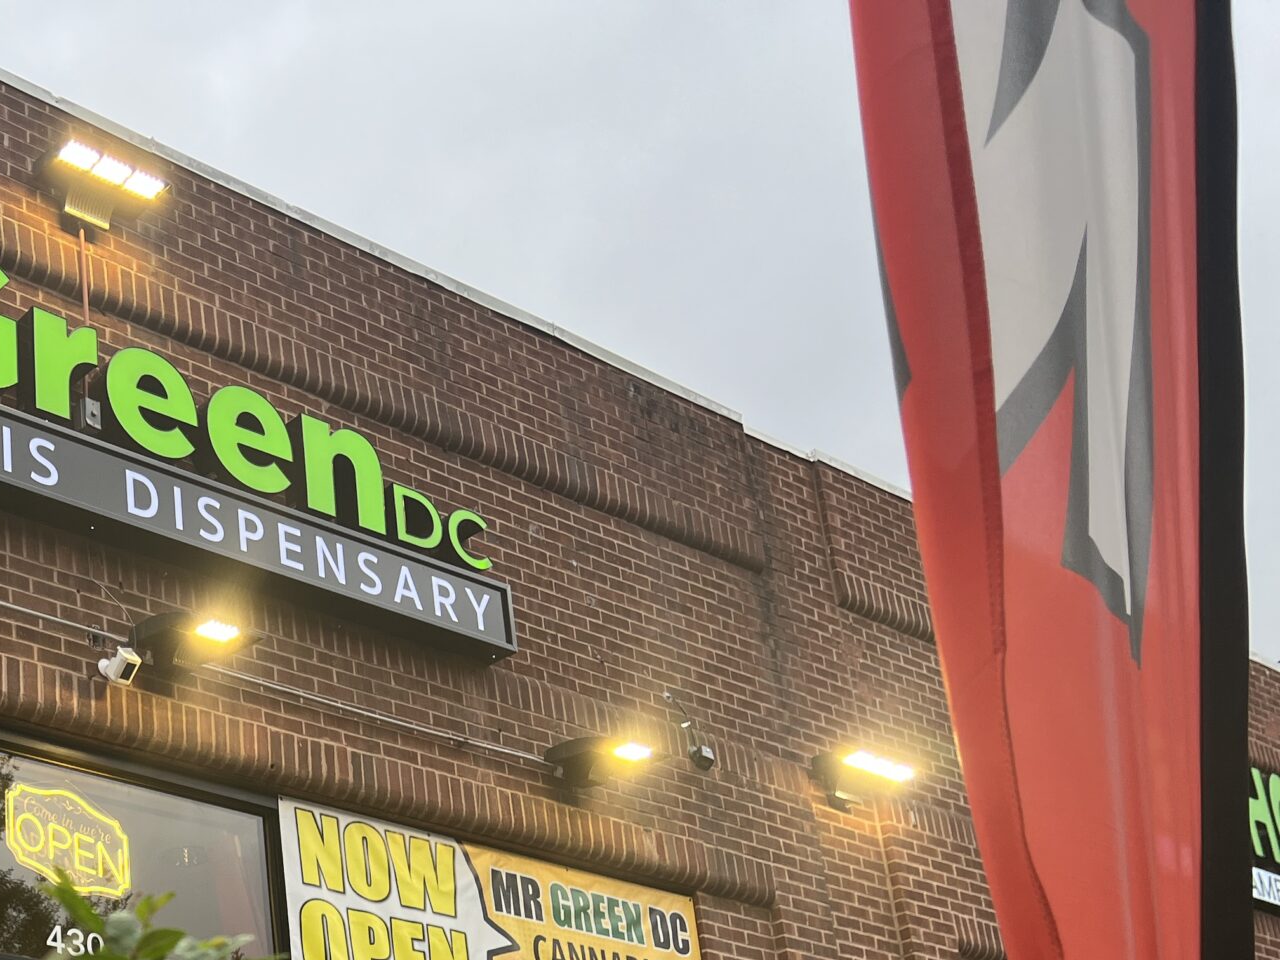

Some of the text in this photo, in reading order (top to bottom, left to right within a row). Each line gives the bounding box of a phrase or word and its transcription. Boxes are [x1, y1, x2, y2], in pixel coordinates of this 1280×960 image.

[125, 470, 493, 632] DISPENSARY
[16, 812, 124, 885] OPEN
[23, 796, 58, 824] Come
[294, 808, 457, 918] NOW
[490, 868, 691, 957] MR GREEN DC
